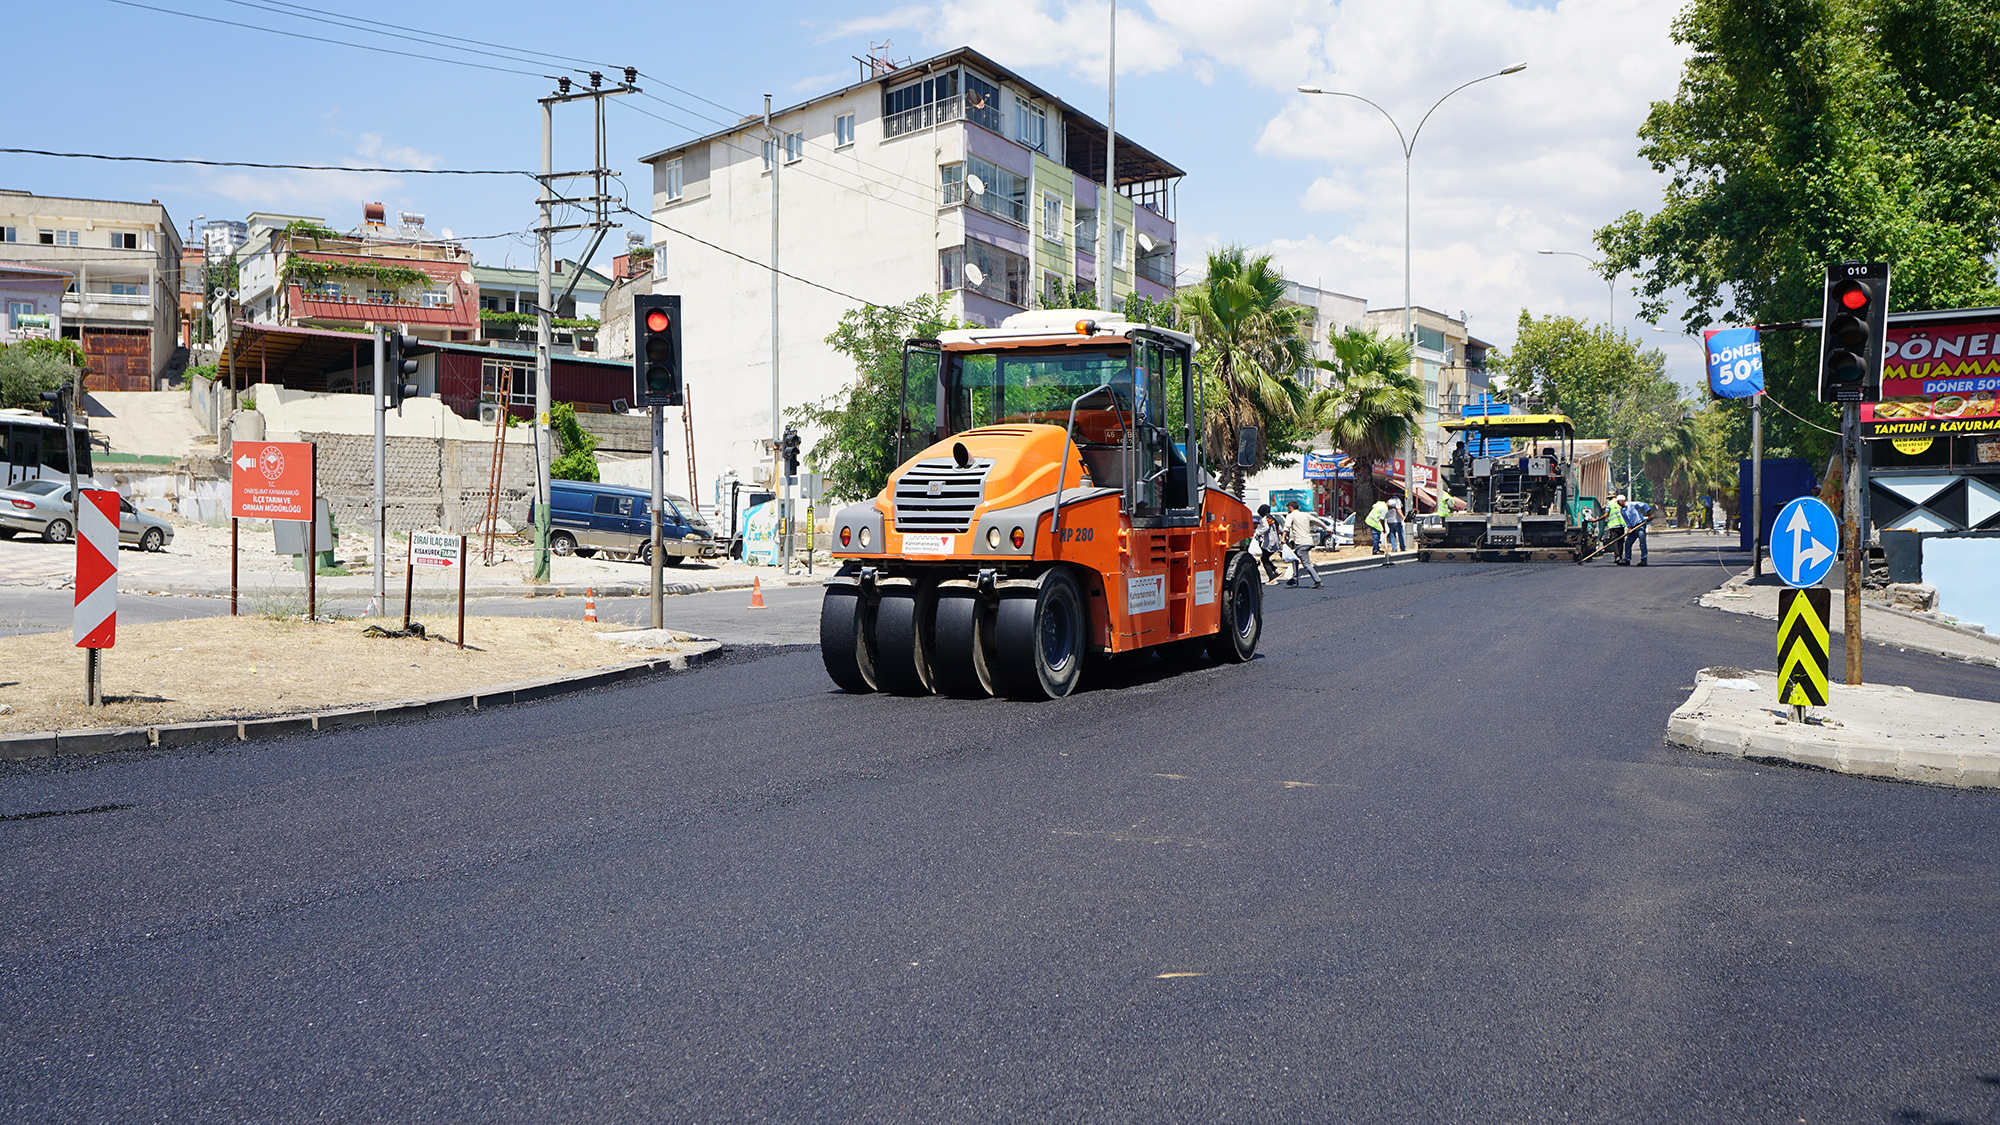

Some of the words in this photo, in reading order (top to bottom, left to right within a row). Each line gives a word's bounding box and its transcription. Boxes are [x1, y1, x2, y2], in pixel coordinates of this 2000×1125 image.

[1847, 266, 1868, 276] 010
[1711, 341, 1761, 366] DÖNER
[1926, 379, 1974, 393] DÖNER
[1874, 420, 1927, 434] TANTUNİ
[1939, 419, 2000, 432] KAVURMA
[252, 495, 265, 504] İLÇE
[265, 496, 283, 504] TARIM
[242, 503, 264, 512] ORMAN
[264, 504, 302, 514] MÜDÜRLÜĞÜ
[1059, 527, 1073, 543] HP
[1075, 527, 1094, 542] 280
